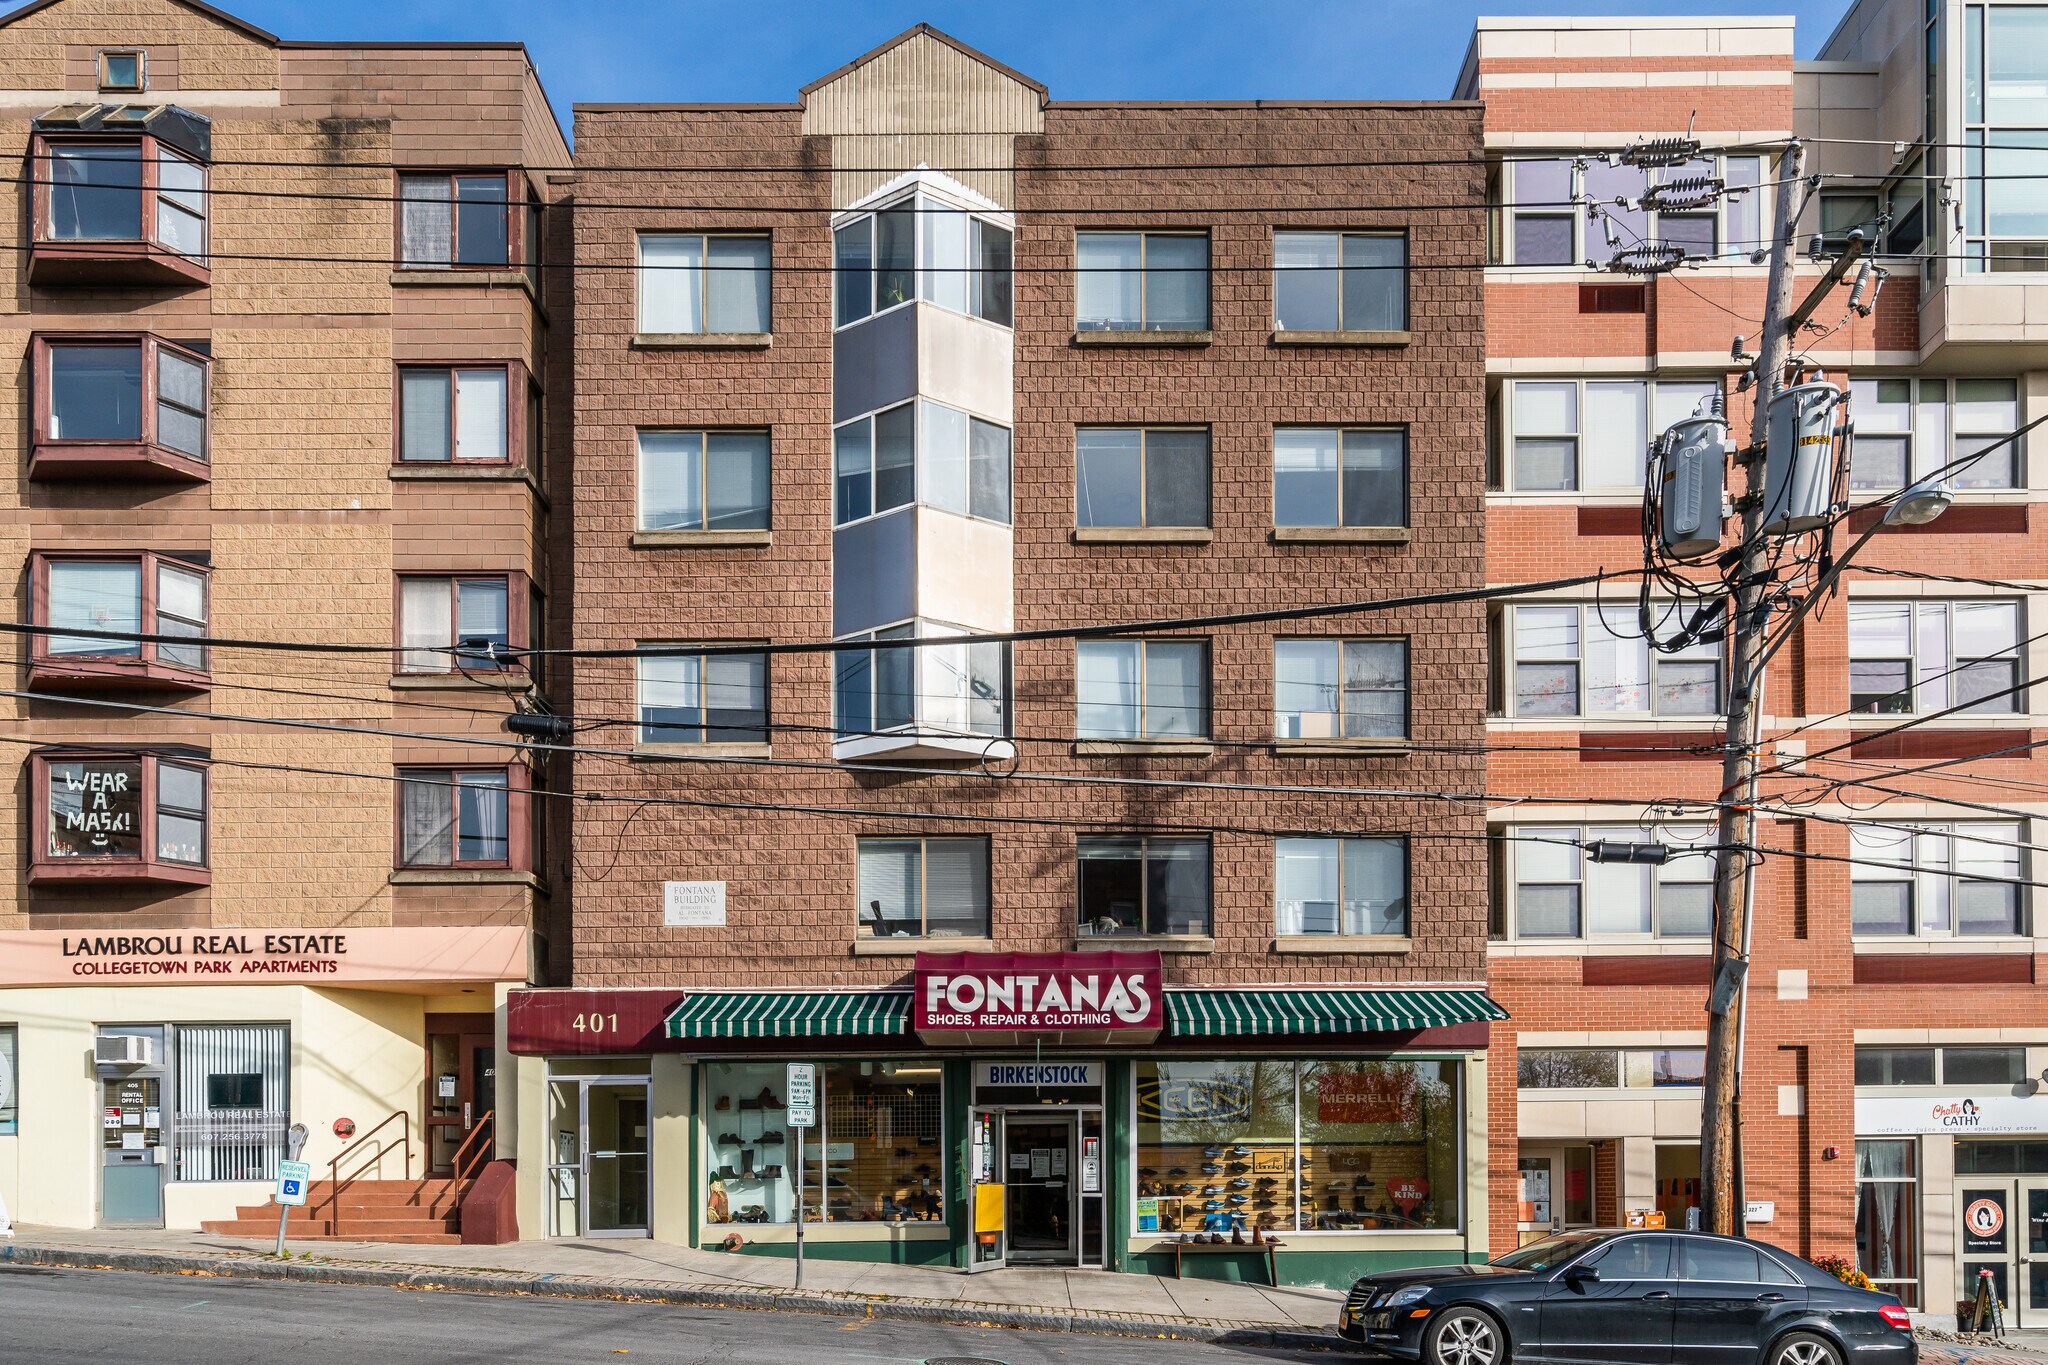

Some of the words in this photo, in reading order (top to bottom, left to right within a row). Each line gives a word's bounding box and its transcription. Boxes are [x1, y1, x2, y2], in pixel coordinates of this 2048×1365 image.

[65, 771, 128, 792] WEAR
[93, 792, 107, 809] A
[66, 811, 130, 832] MASK!
[674, 886, 716, 895] FONTANA
[674, 895, 717, 904] BUILDING
[62, 936, 183, 956] LAMBROU
[192, 935, 254, 955] REAL
[264, 934, 348, 954] ESTATE
[72, 961, 187, 975] COLLEGETOWN
[193, 961, 232, 973] PARK
[240, 960, 338, 973] APARTMENTS
[926, 974, 1151, 1023] FONTANAS
[572, 1012, 618, 1033] 401
[927, 1014, 975, 1027] SHOES,
[979, 1013, 1027, 1025] REPAIR
[1030, 1013, 1040, 1025] &
[1044, 1013, 1111, 1025] CLOTHING
[989, 1066, 1088, 1084] BIRKENSTOCK
[790, 1080, 812, 1088] PARKING
[1137, 1085, 1240, 1112] KEEN
[1322, 1093, 1396, 1104] MERRELL
[176, 1111, 225, 1120] LAMBROU
[227, 1110, 254, 1119] REAL
[256, 1110, 291, 1119] ESTATE
[1932, 1103, 1961, 1119] Chatty
[1943, 1115, 1981, 1126] CATHY
[1974, 1125, 2012, 1133] specialty
[200, 1132, 268, 1141] 607.256.3778
[281, 1171, 304, 1179] PARKING
[1401, 1184, 1415, 1192] BE
[1394, 1191, 1422, 1199] KIND
